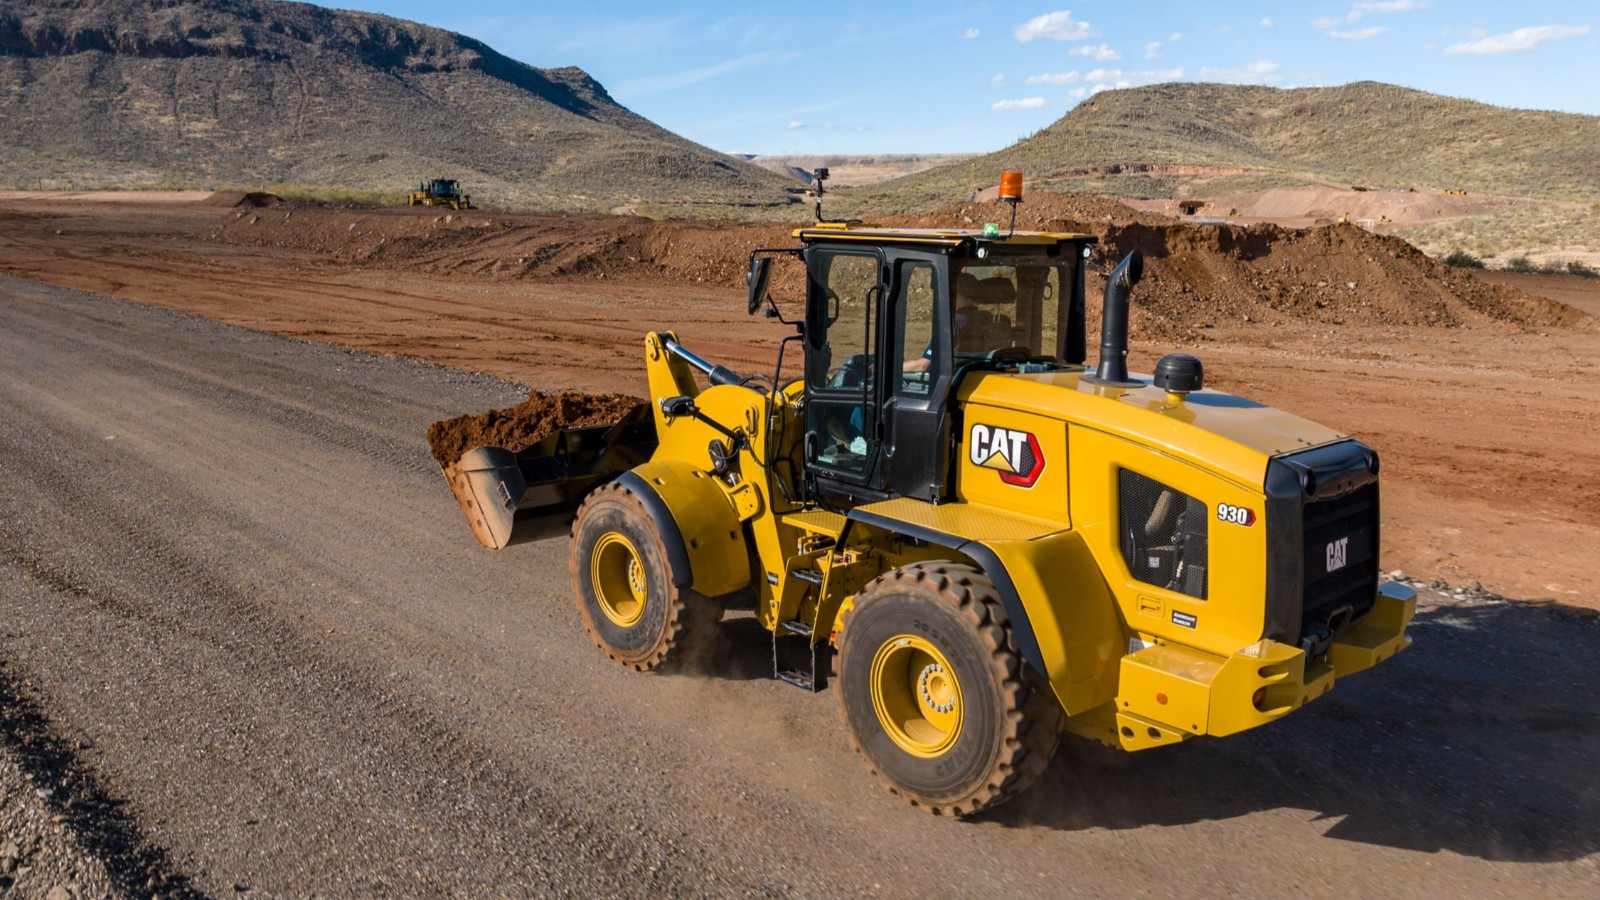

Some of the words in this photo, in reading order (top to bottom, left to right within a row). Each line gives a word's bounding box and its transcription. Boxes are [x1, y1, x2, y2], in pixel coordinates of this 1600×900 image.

[970, 423, 1028, 473] CAT
[1217, 503, 1248, 525] 930
[1326, 536, 1348, 573] CAT
